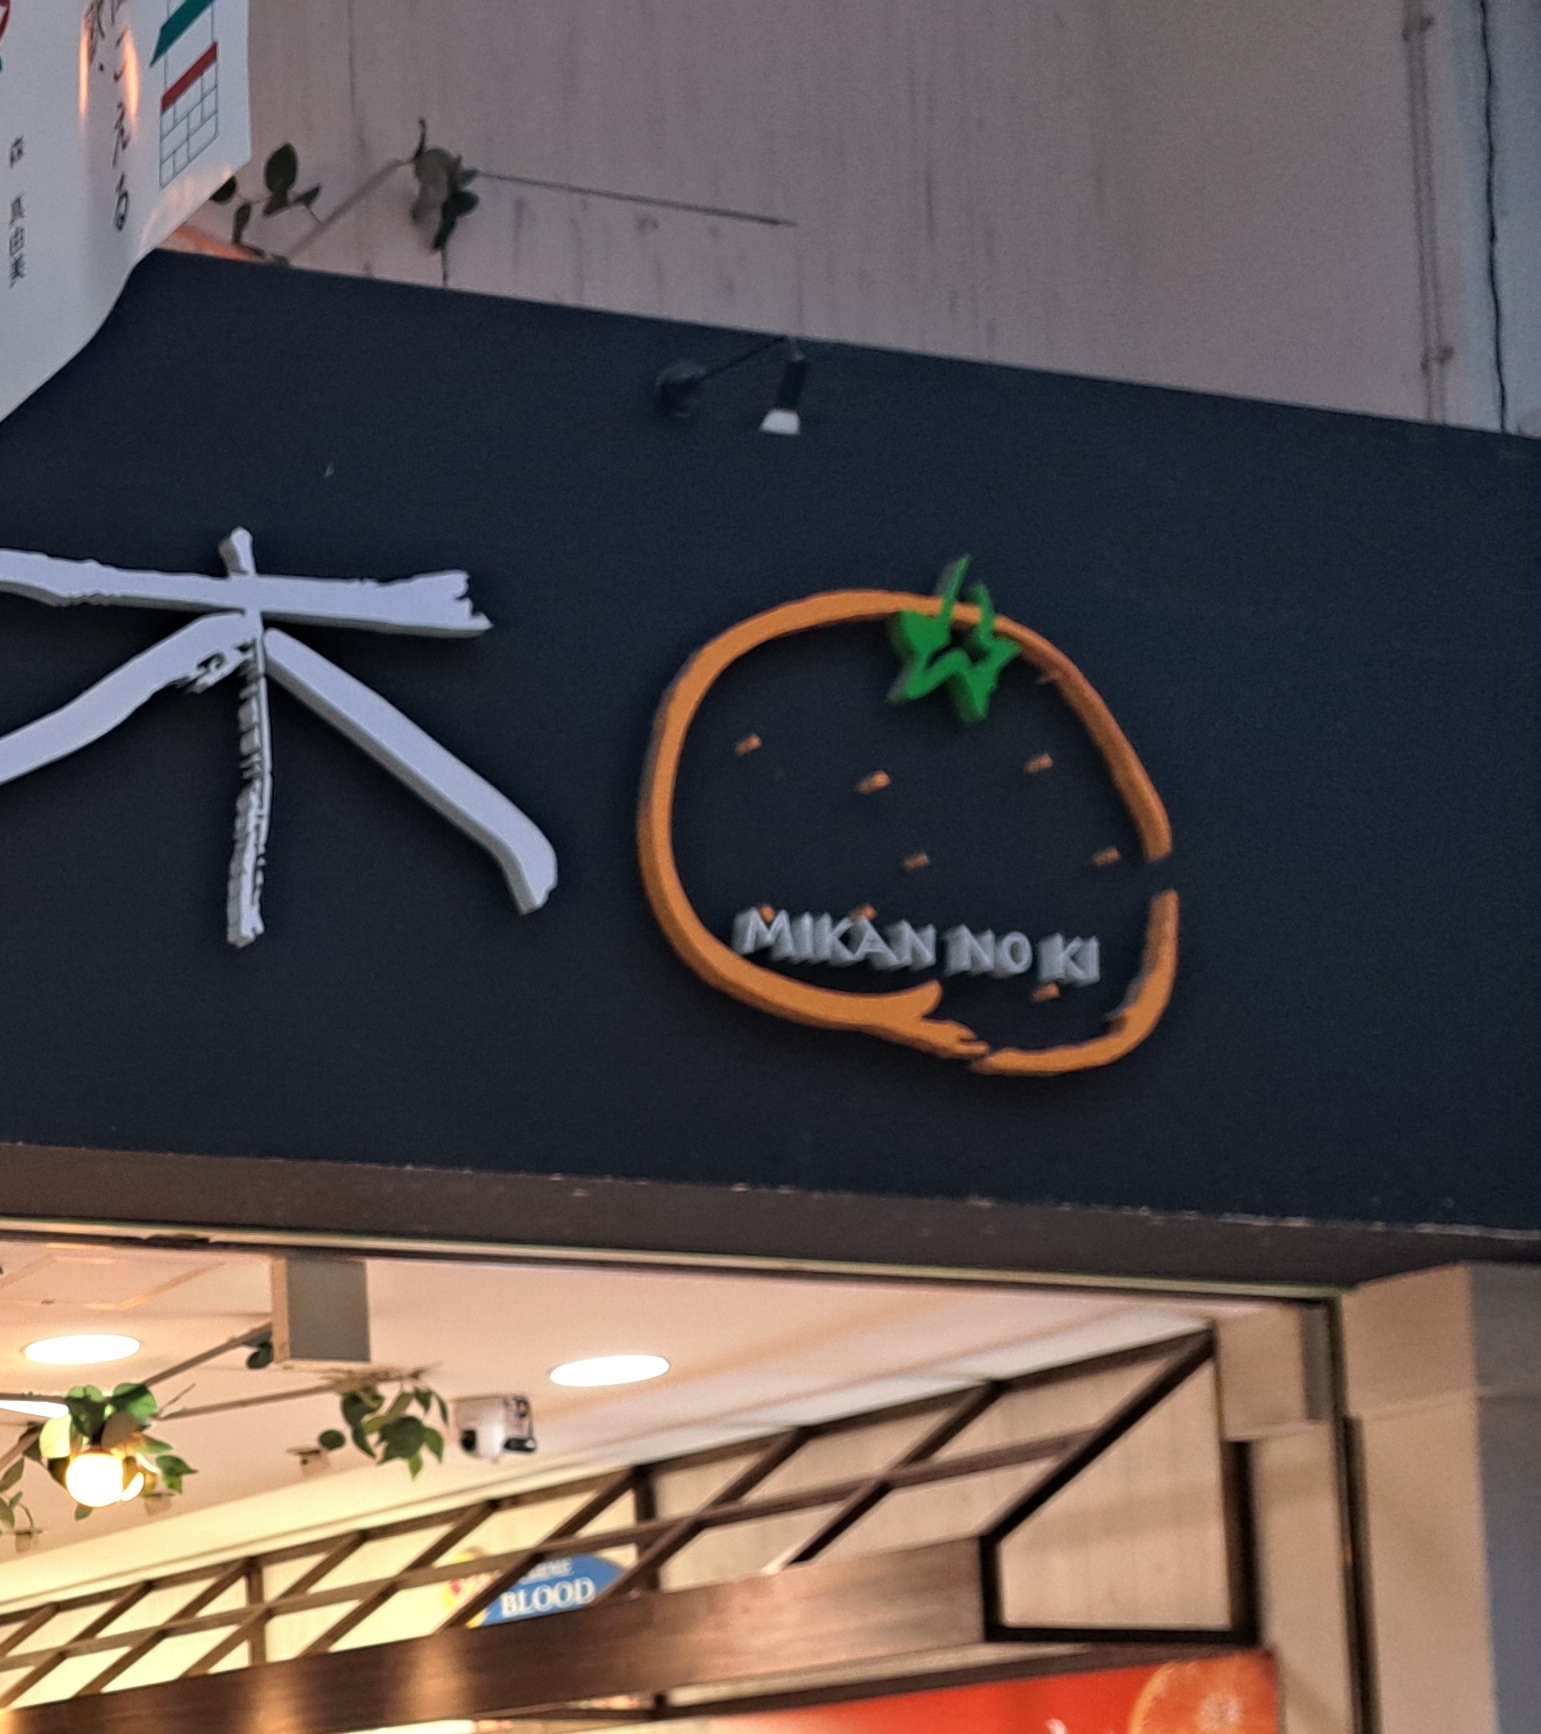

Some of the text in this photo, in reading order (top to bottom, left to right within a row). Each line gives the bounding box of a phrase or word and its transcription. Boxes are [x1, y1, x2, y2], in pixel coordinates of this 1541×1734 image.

[735, 908, 1101, 986] MIKAN NO KI
[500, 1576, 597, 1619] BLOOD
